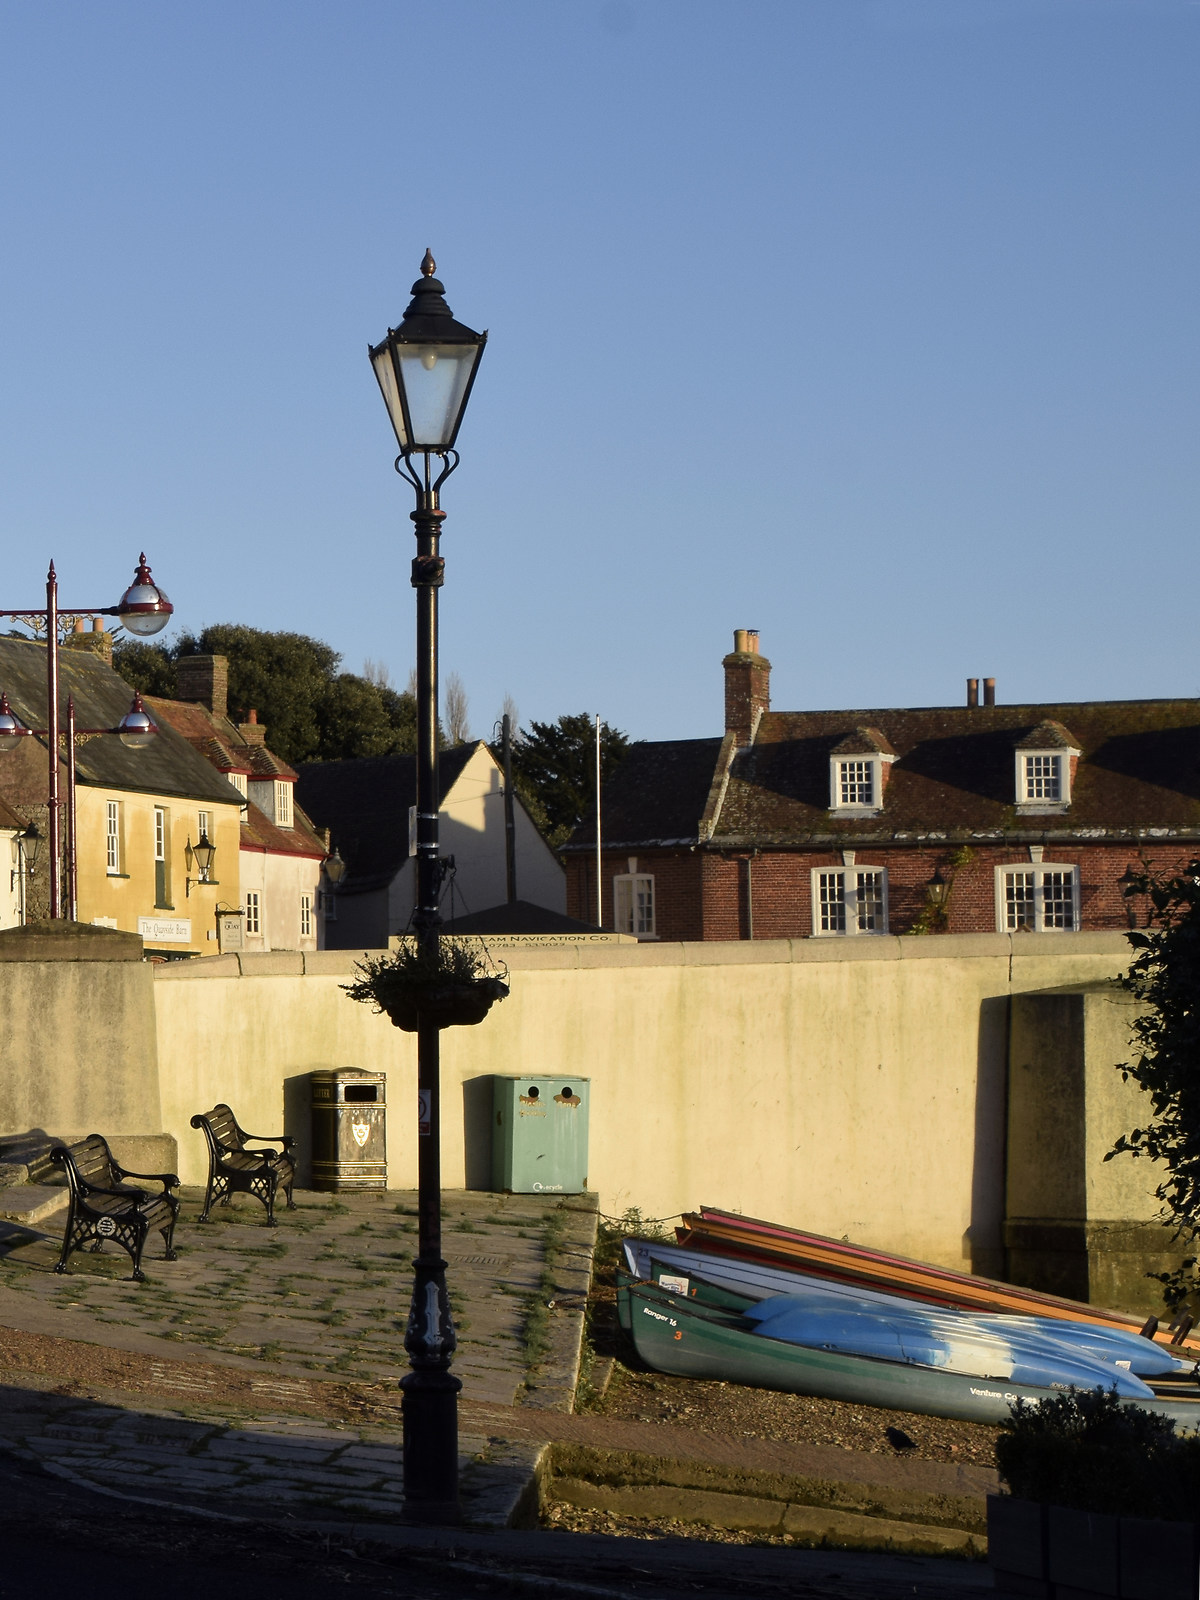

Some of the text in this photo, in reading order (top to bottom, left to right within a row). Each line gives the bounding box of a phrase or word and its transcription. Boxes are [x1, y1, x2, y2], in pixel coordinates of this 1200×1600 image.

[638, 1248, 649, 1257] 23
[643, 1307, 677, 1327] Ranger 16
[674, 1331, 682, 1340] 3
[970, 1387, 1037, 1404] Venture Caoes
